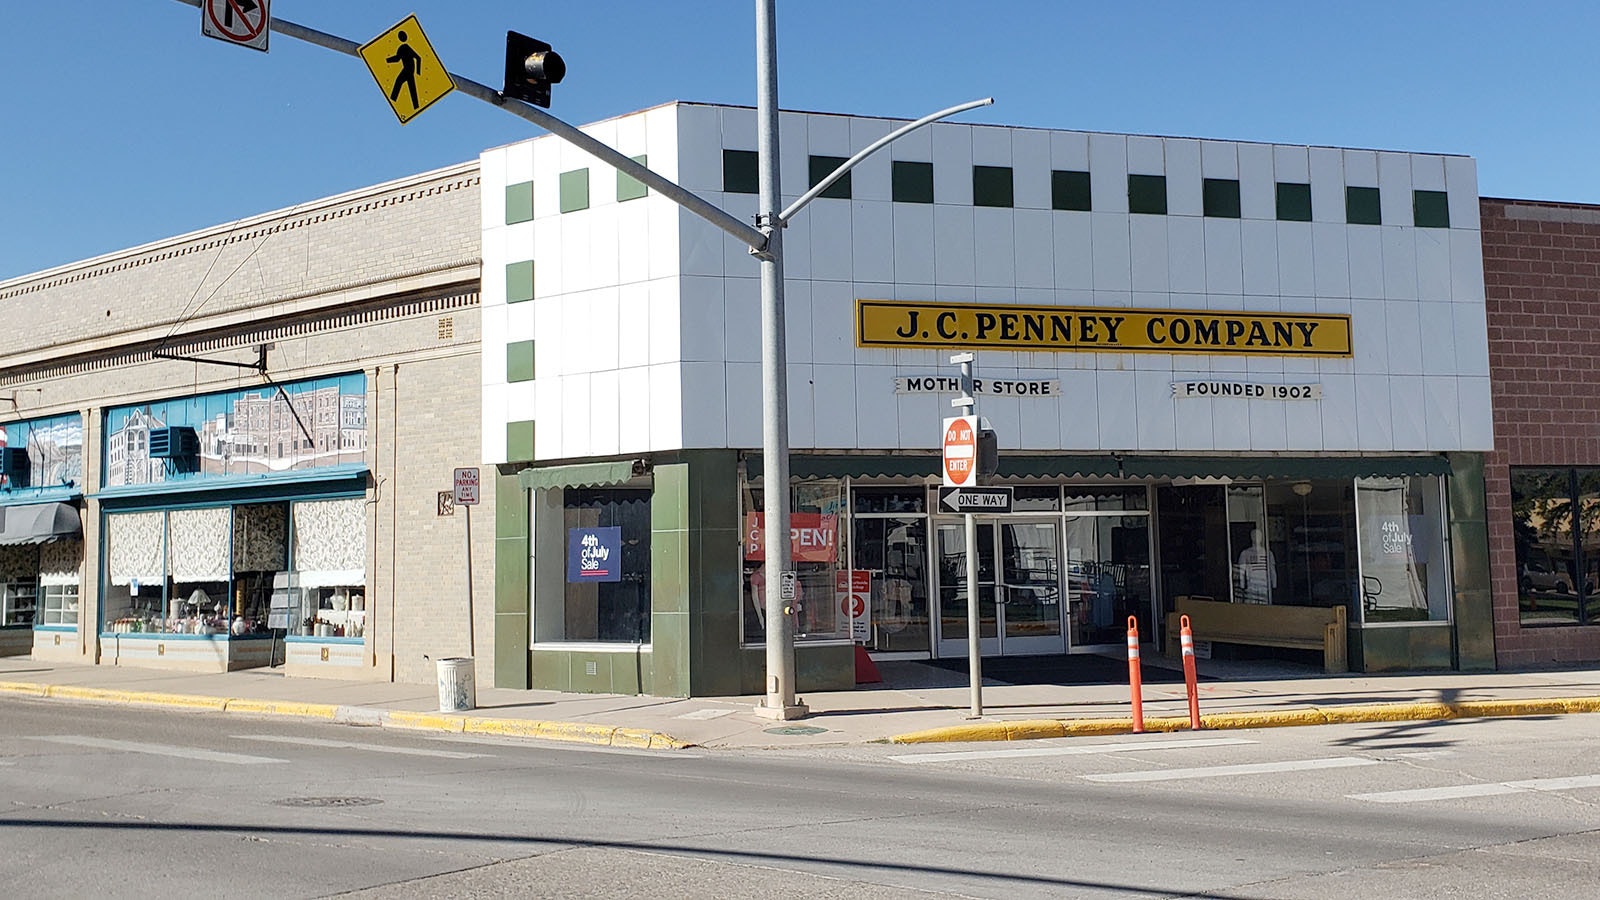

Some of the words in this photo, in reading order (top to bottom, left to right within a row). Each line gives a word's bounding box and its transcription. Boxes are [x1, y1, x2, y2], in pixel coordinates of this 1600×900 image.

[1147, 317, 1319, 347] COMPANY
[907, 378, 983, 392] MOTHR
[993, 381, 1050, 394] STORE
[1186, 383, 1264, 397] FOUNDED
[1273, 386, 1311, 398] 1902
[948, 430, 956, 442] DO
[960, 429, 971, 441] NOT
[949, 460, 968, 471] ENTER
[958, 495, 978, 505] ONE
[982, 495, 1005, 505] WAY
[1382, 521, 1399, 532] 4th
[581, 534, 598, 546] 4th
[790, 528, 833, 546] PEN!
[1382, 532, 1391, 543] of
[1391, 532, 1413, 545] July
[581, 546, 591, 558] of
[590, 546, 609, 561] July
[1383, 543, 1402, 553] Sale
[581, 559, 599, 570] Sale
